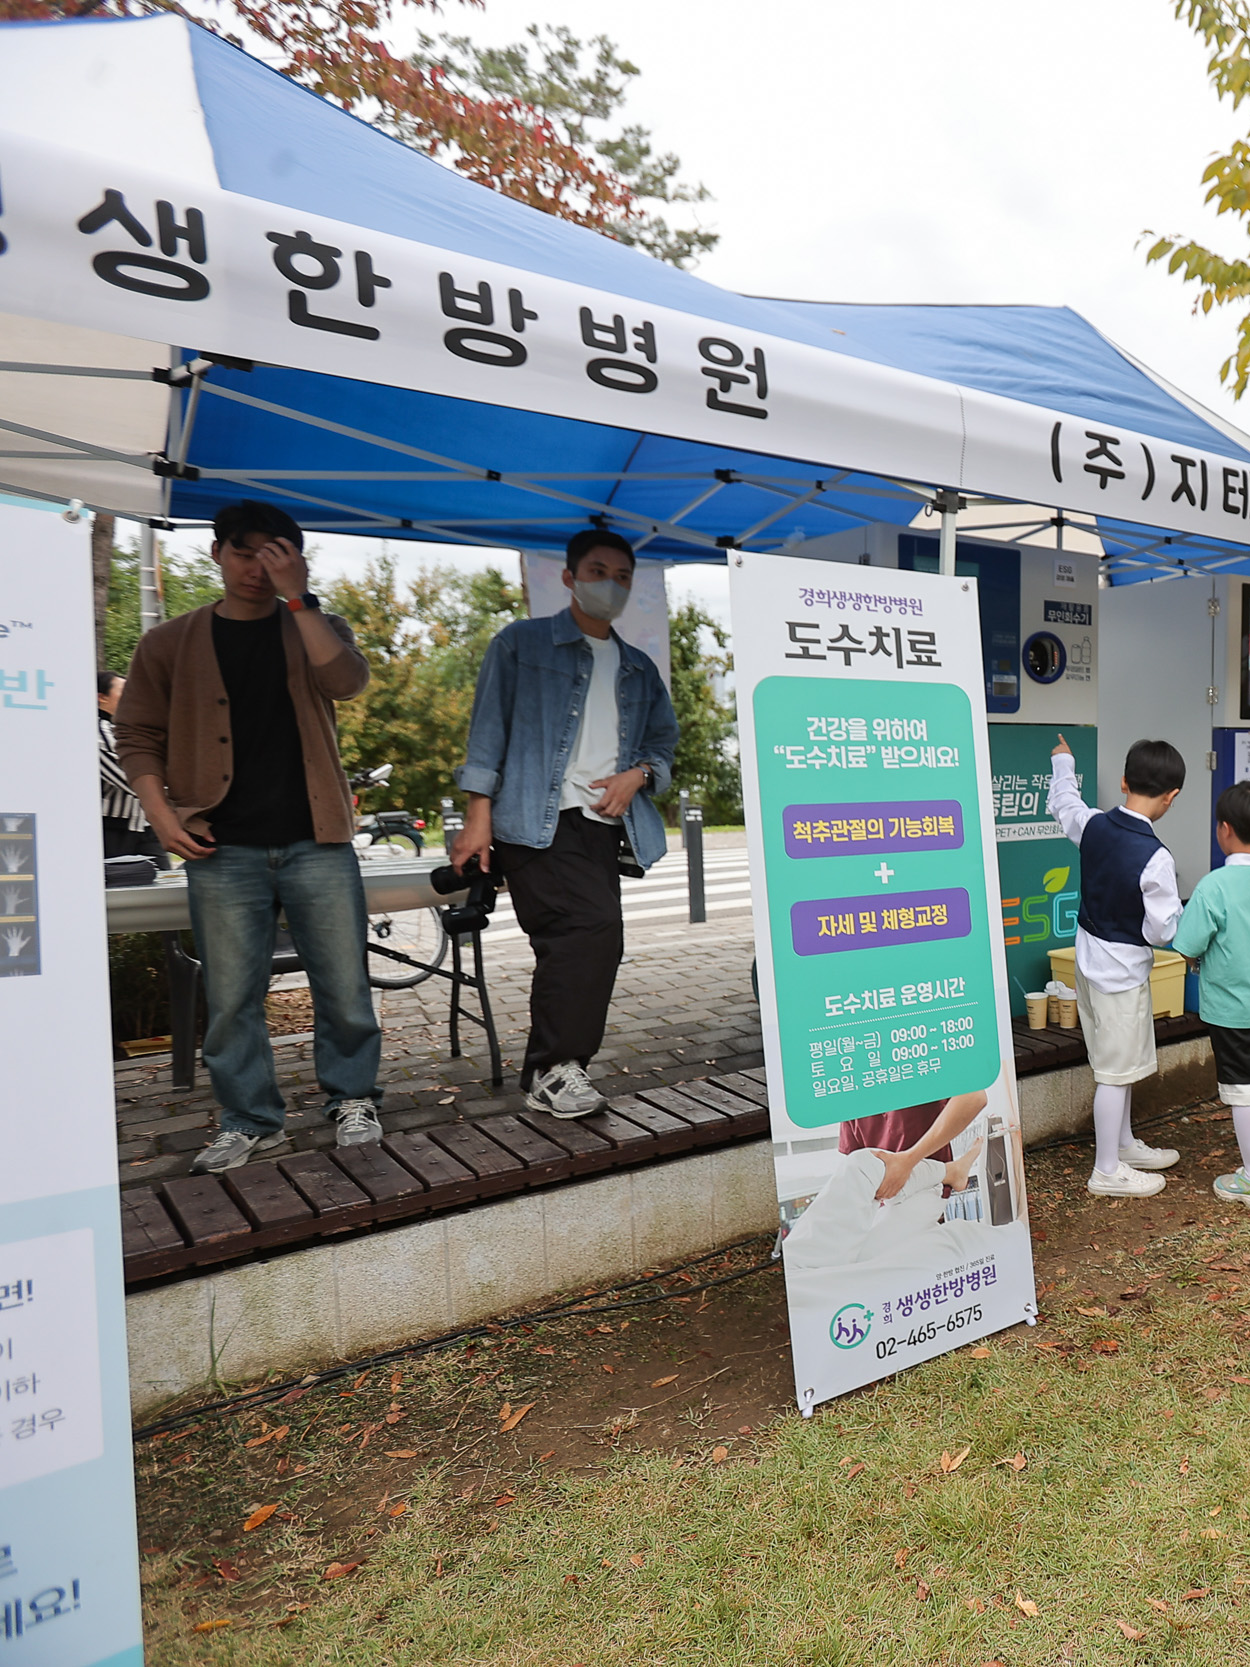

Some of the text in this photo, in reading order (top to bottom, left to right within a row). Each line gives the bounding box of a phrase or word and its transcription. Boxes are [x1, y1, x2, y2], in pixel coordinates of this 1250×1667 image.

[0, 163, 768, 420] 생한방병원
[798, 587, 924, 617] 경희생생한방병원
[1047, 609, 1089, 625] 무인회수기
[784, 621, 942, 669] 도수치료
[805, 716, 929, 742] 건강을 위하여
[774, 745, 960, 770] “도수치료” 받으세요!
[793, 814, 956, 844] 척추관절의 기능회복
[817, 904, 949, 938] 자세 및 체형교정
[825, 976, 965, 1018] 도수치료 운영시간
[808, 1031, 882, 1058] 평일(월~금)
[890, 1026, 927, 1044] 09:00
[940, 1016, 974, 1034] 18:00
[891, 1044, 929, 1063] 09:00
[941, 1034, 975, 1052] 13:00
[812, 1057, 942, 1099] 일요일, 공휴일은 휴무
[895, 1264, 998, 1318] 생생한방병원
[876, 1303, 983, 1360] 02-465-6575
[12, 1408, 66, 1440] 경우
